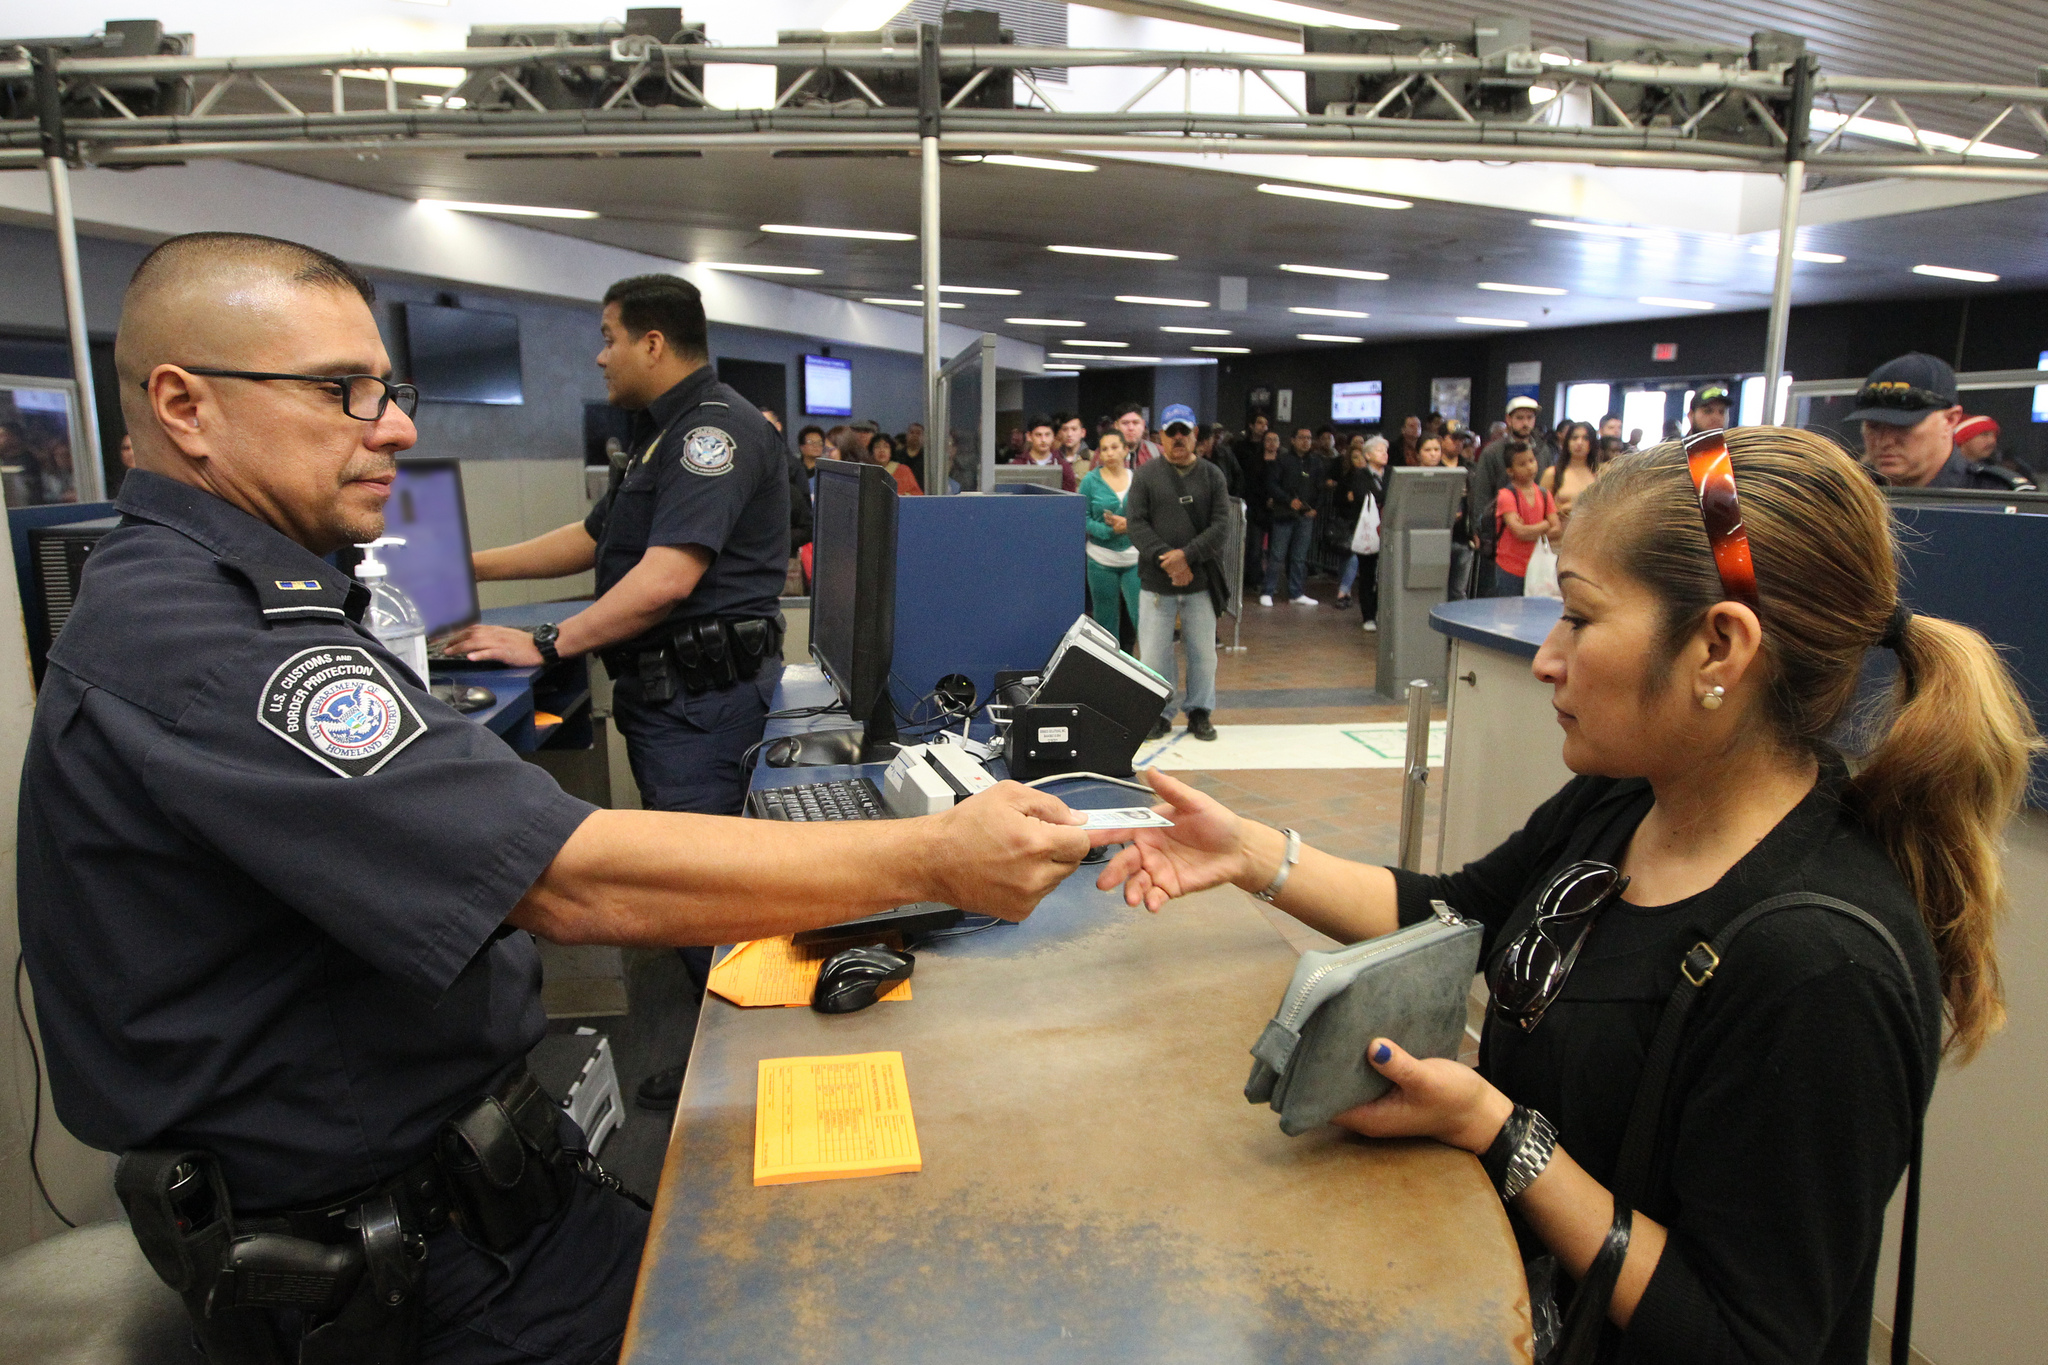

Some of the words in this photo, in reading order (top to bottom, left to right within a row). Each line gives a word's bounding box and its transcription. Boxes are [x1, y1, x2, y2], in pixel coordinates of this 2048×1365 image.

[270, 693, 287, 712] U.S.
[281, 653, 333, 690] CUSTOMS
[287, 688, 309, 733] BORDER
[303, 664, 373, 691] PROTECTION
[310, 682, 365, 717] DEPARTMENT
[367, 685, 380, 694] OF
[326, 740, 382, 757] HOMELAND
[382, 699, 397, 740] SECURITY
